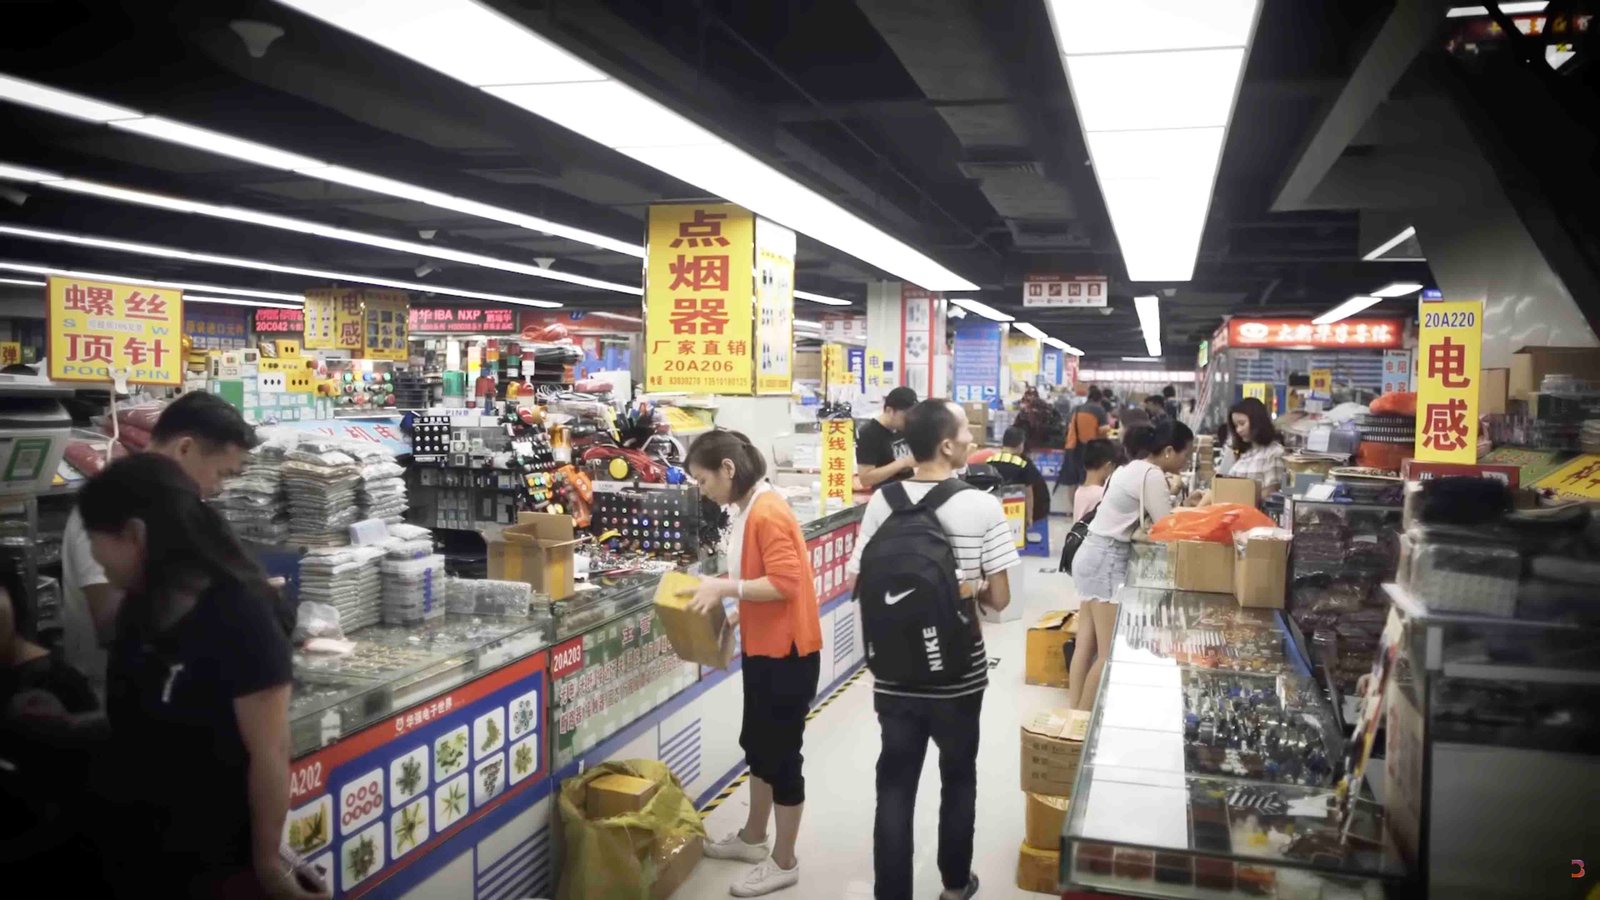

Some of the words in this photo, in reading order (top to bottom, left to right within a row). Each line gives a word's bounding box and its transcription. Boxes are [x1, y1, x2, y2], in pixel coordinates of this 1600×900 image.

[669, 209, 731, 335] 点烟器
[64, 284, 169, 321] 螺丝
[457, 310, 481, 320] NXP
[256, 321, 288, 331] 20C042
[341, 292, 361, 346] 电感
[1425, 312, 1475, 328] 20A220
[63, 333, 170, 368] 顶针
[652, 339, 747, 356] 厂家直销
[135, 369, 170, 379] PIN
[664, 360, 734, 372] 20A206
[1421, 336, 1471, 452] 电感
[553, 645, 582, 673] 20A203
[922, 625, 944, 672] NIKE
